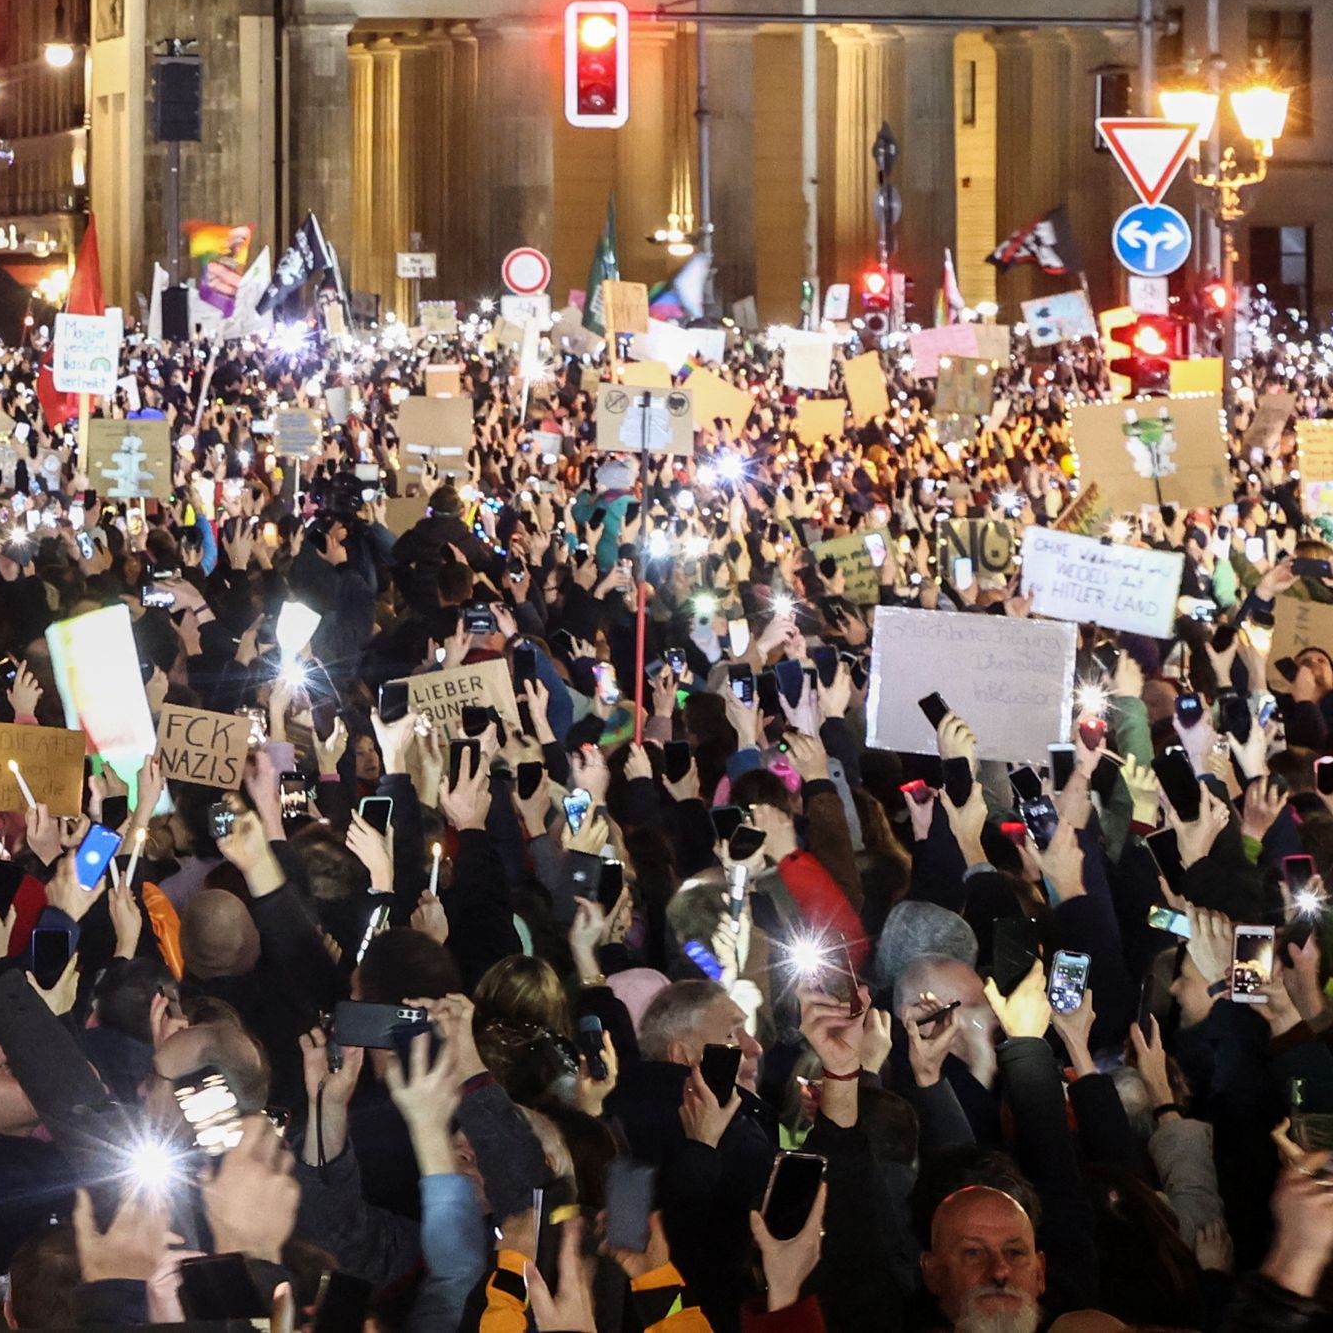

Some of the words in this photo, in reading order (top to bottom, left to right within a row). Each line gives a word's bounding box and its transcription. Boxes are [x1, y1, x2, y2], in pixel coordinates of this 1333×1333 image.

[1034, 538, 1070, 557] OHNE
[1052, 581, 1159, 616] HITLER-LAND
[413, 676, 484, 704] LIEBER
[167, 714, 235, 754] FCK
[159, 747, 238, 785] NAZIS
